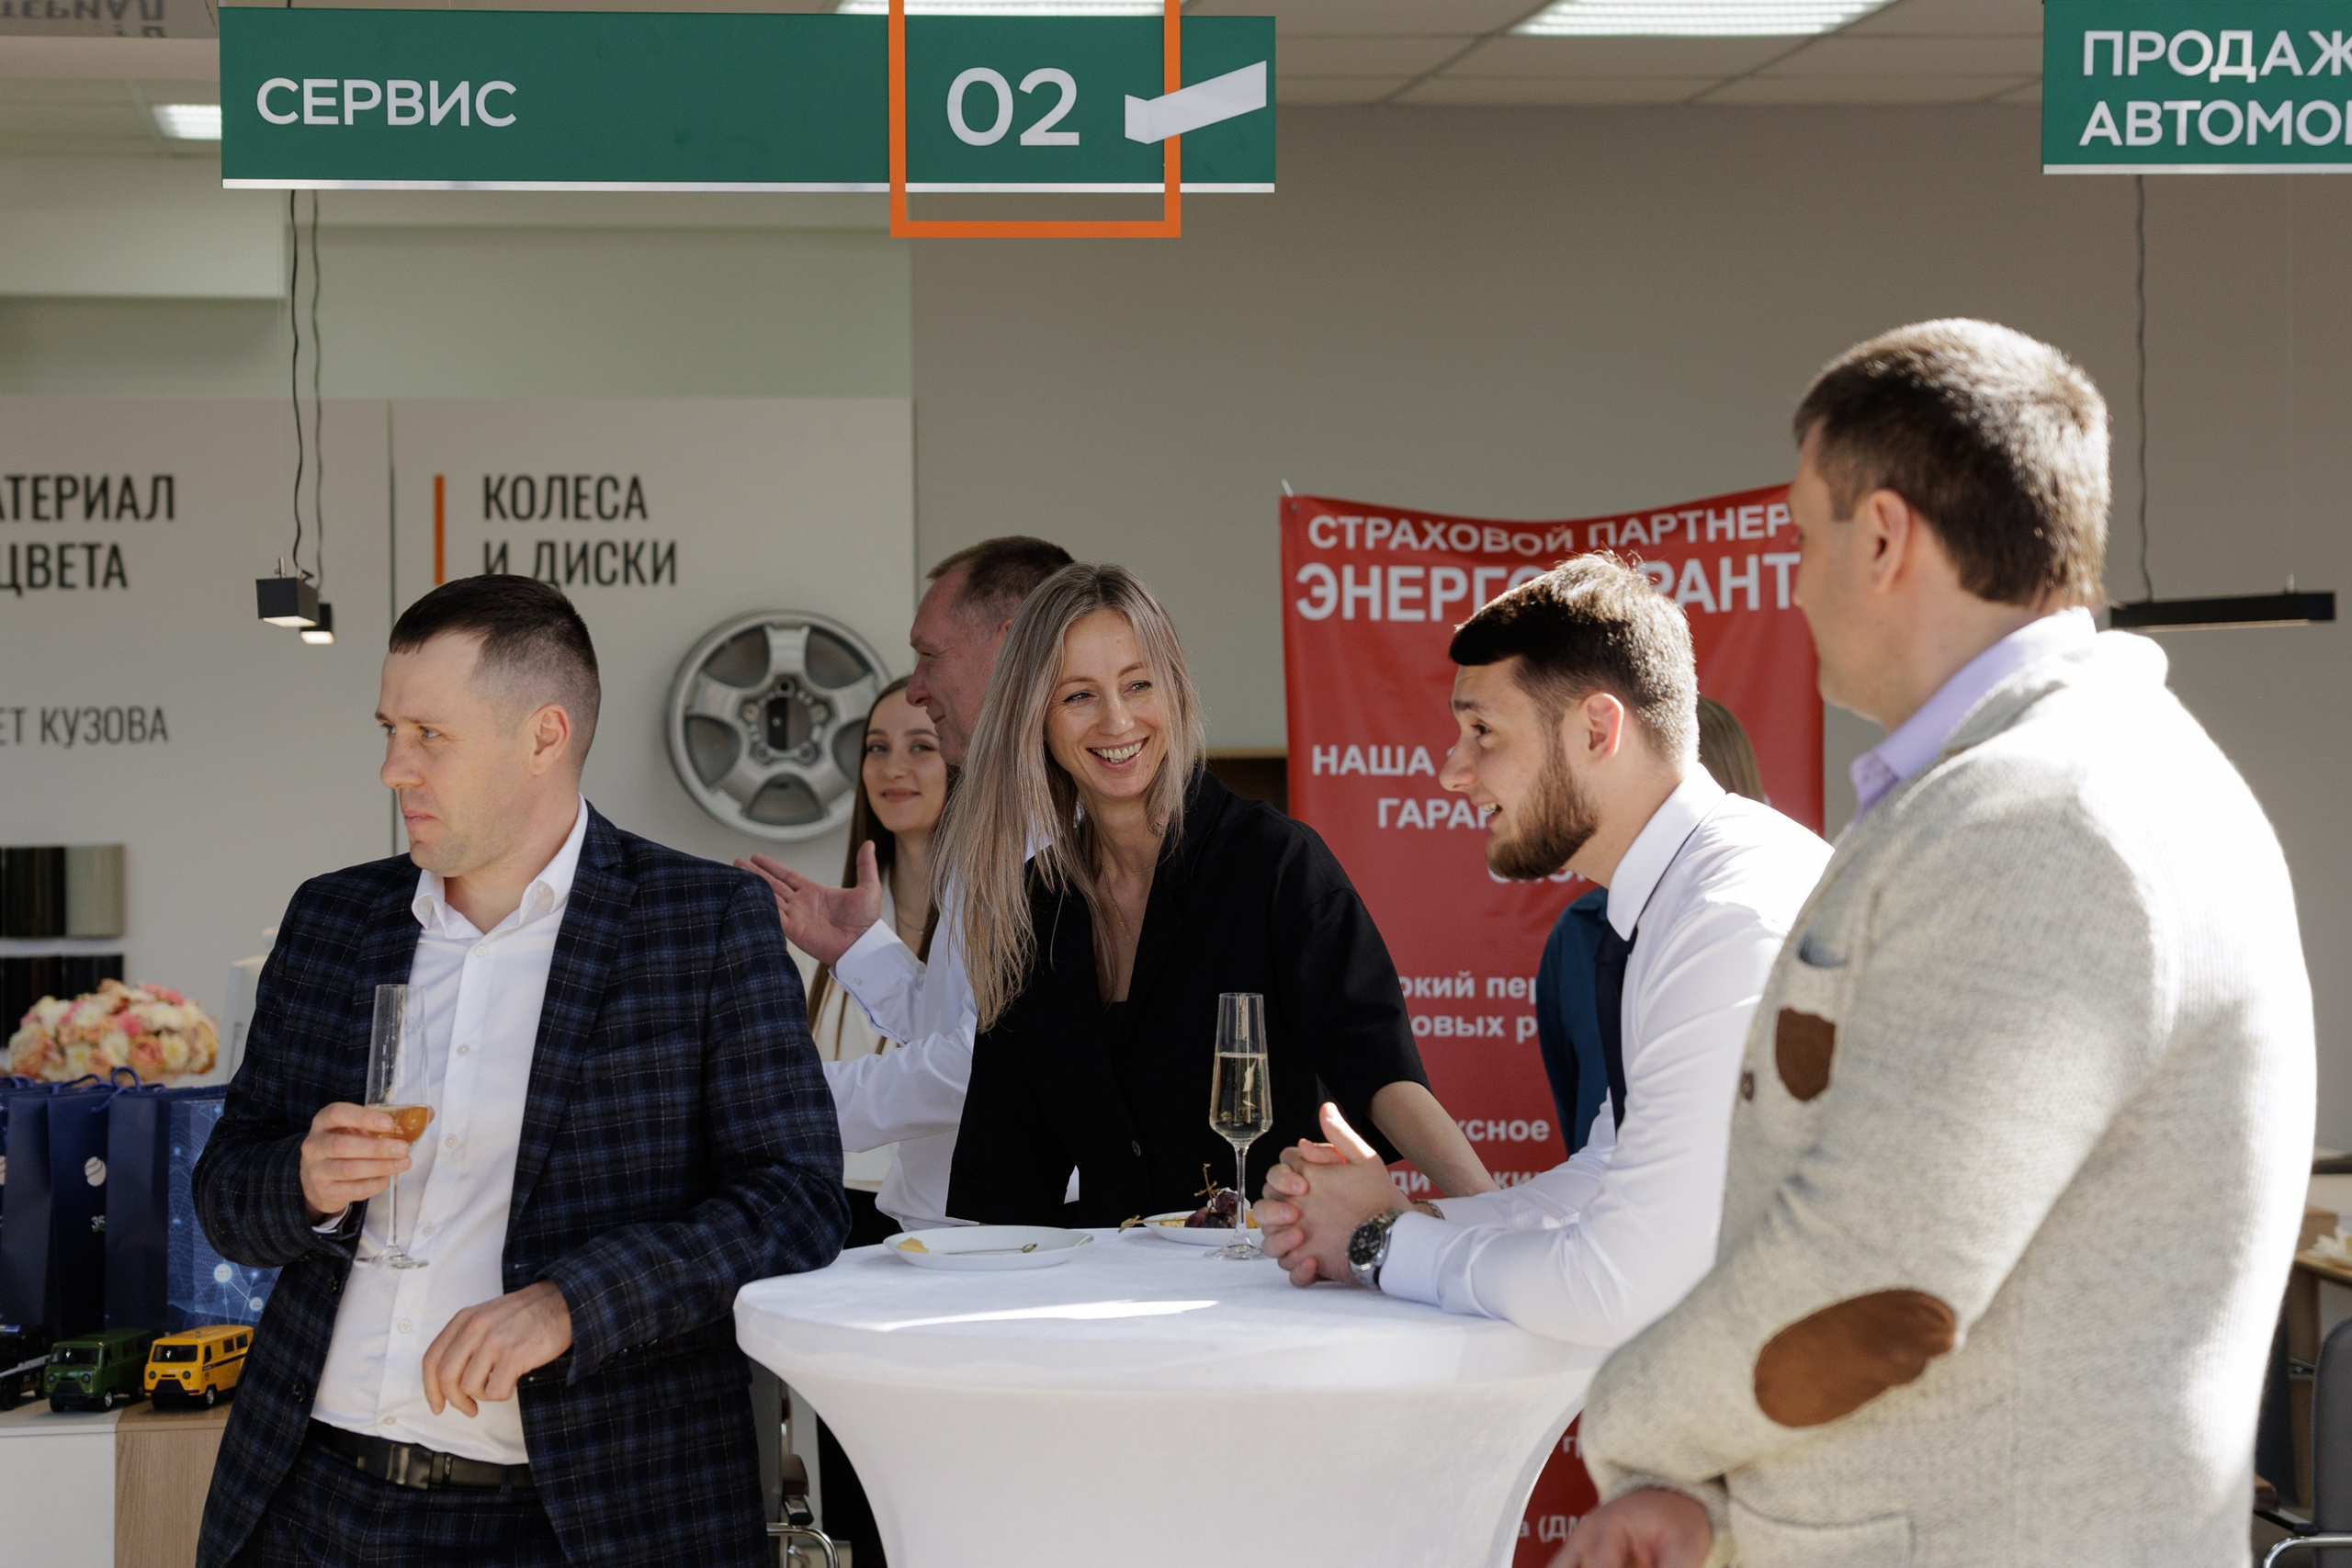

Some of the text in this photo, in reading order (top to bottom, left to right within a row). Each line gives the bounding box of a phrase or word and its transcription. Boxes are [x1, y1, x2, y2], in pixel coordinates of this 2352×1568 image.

[2083, 29, 2352, 83] ПРОДАЖ
[256, 77, 517, 127] СЕРВИС
[946, 67, 1080, 146] 02
[2078, 100, 2352, 146] АВТОМО
[0, 475, 174, 521] ТЕРИАЛ
[484, 475, 648, 521] КОЛЕСА
[1308, 503, 1791, 556] СТРАХОВОЙ ПАРТНЕР
[484, 541, 676, 588] И ДИСКИ
[1296, 552, 1801, 622] ЭНЕРГРАНТ
[41, 705, 168, 749] КУЗОВА
[1312, 744, 1436, 776] НАША
